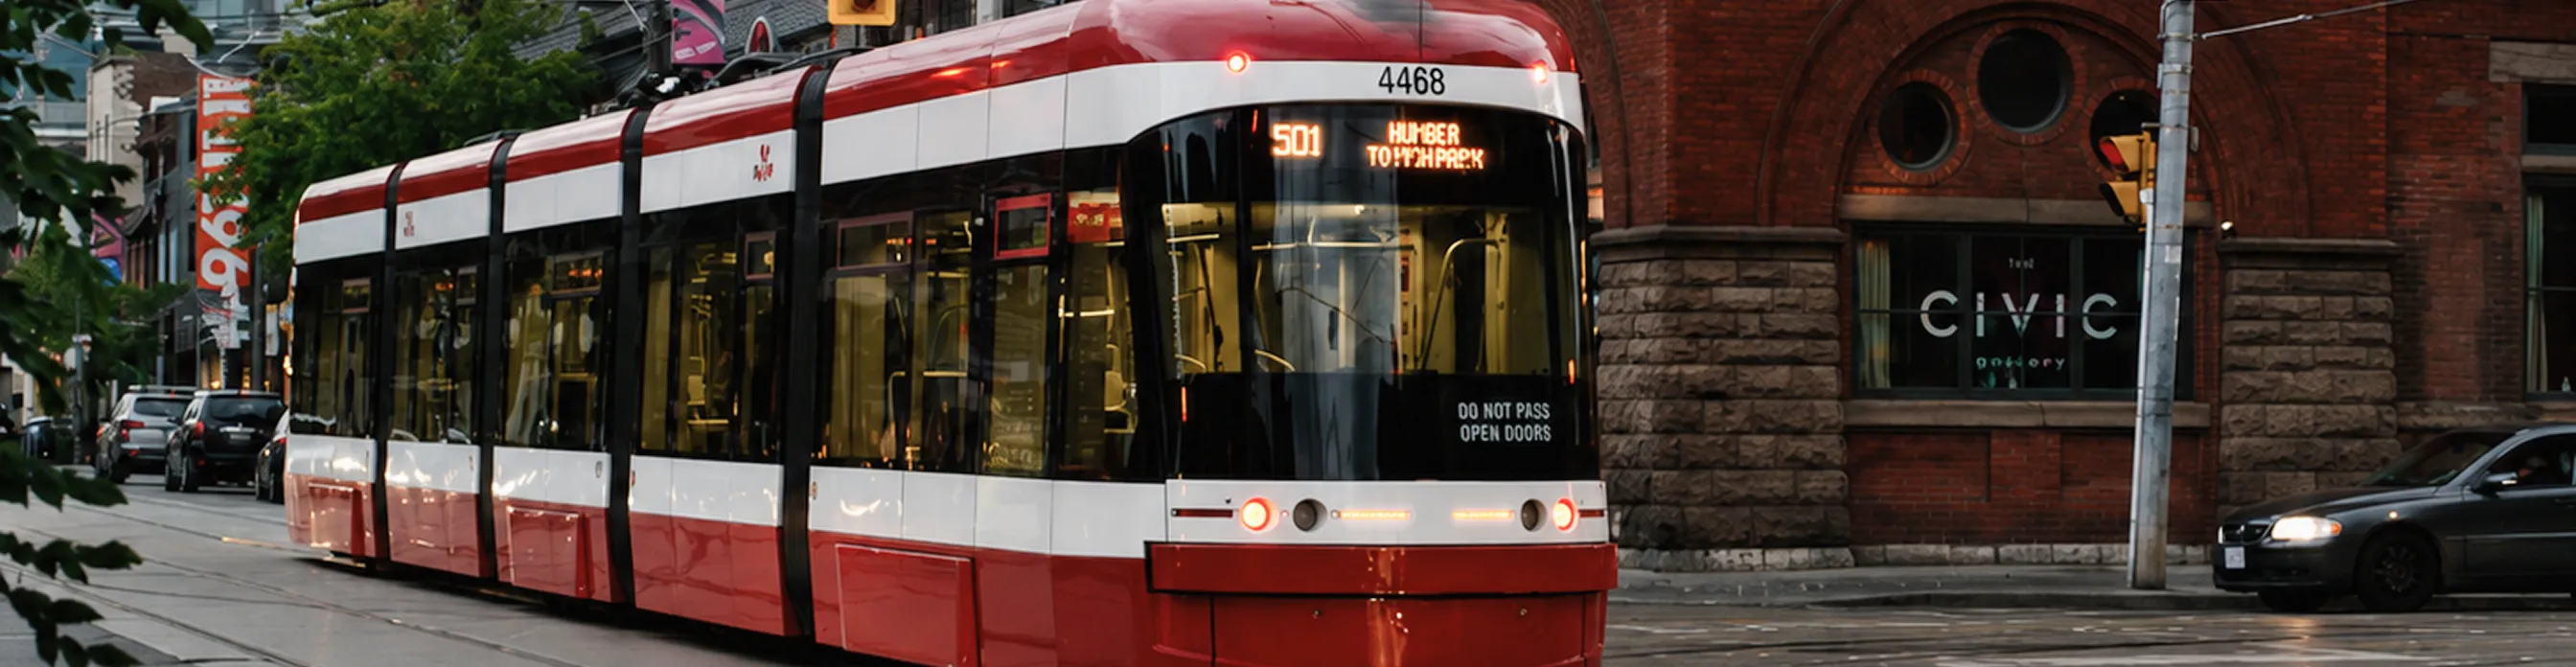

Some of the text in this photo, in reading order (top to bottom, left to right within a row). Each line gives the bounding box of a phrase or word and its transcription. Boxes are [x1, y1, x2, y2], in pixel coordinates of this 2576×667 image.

[1378, 65, 1445, 95] 4468
[1272, 124, 1321, 157] 501
[1366, 145, 1392, 168] TO
[1920, 289, 2117, 339] CIVIC
[1458, 402, 1551, 420] DO NOT PASS
[1460, 424, 1552, 442] OPEN DOORS
